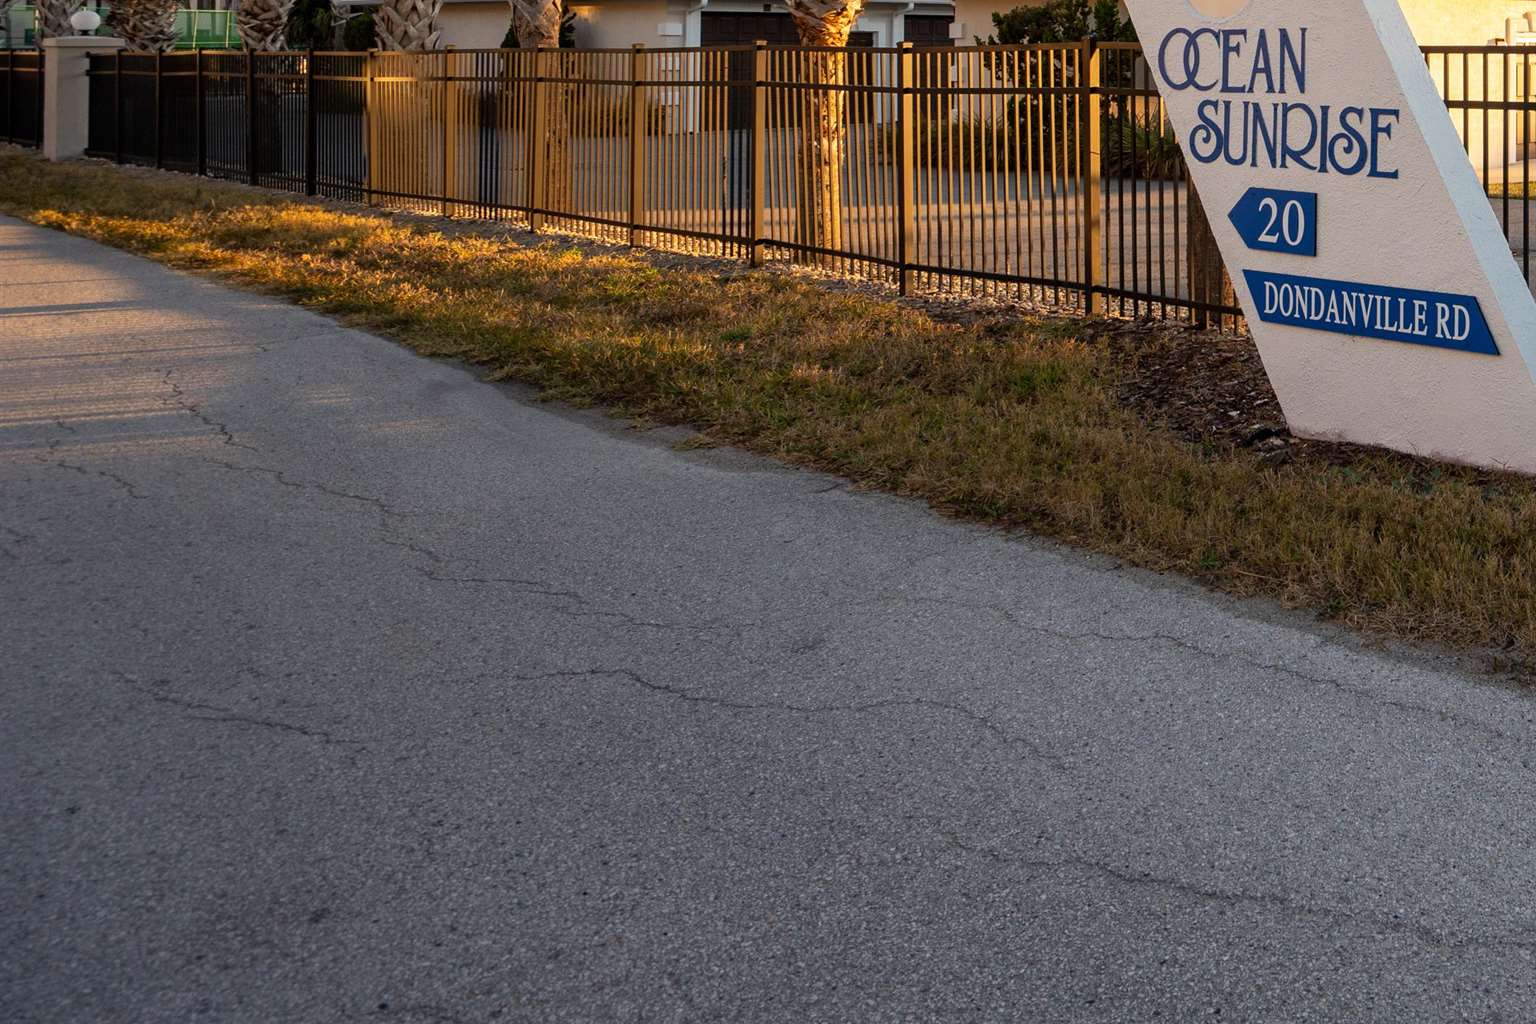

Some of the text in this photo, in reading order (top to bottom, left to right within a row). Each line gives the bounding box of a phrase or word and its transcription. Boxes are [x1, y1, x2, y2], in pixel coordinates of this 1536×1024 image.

[1158, 27, 1308, 94] OCEAN
[1189, 99, 1399, 179] SUNRISE
[1257, 197, 1305, 245] 20
[1264, 281, 1470, 341] DONDANVILLE RD
